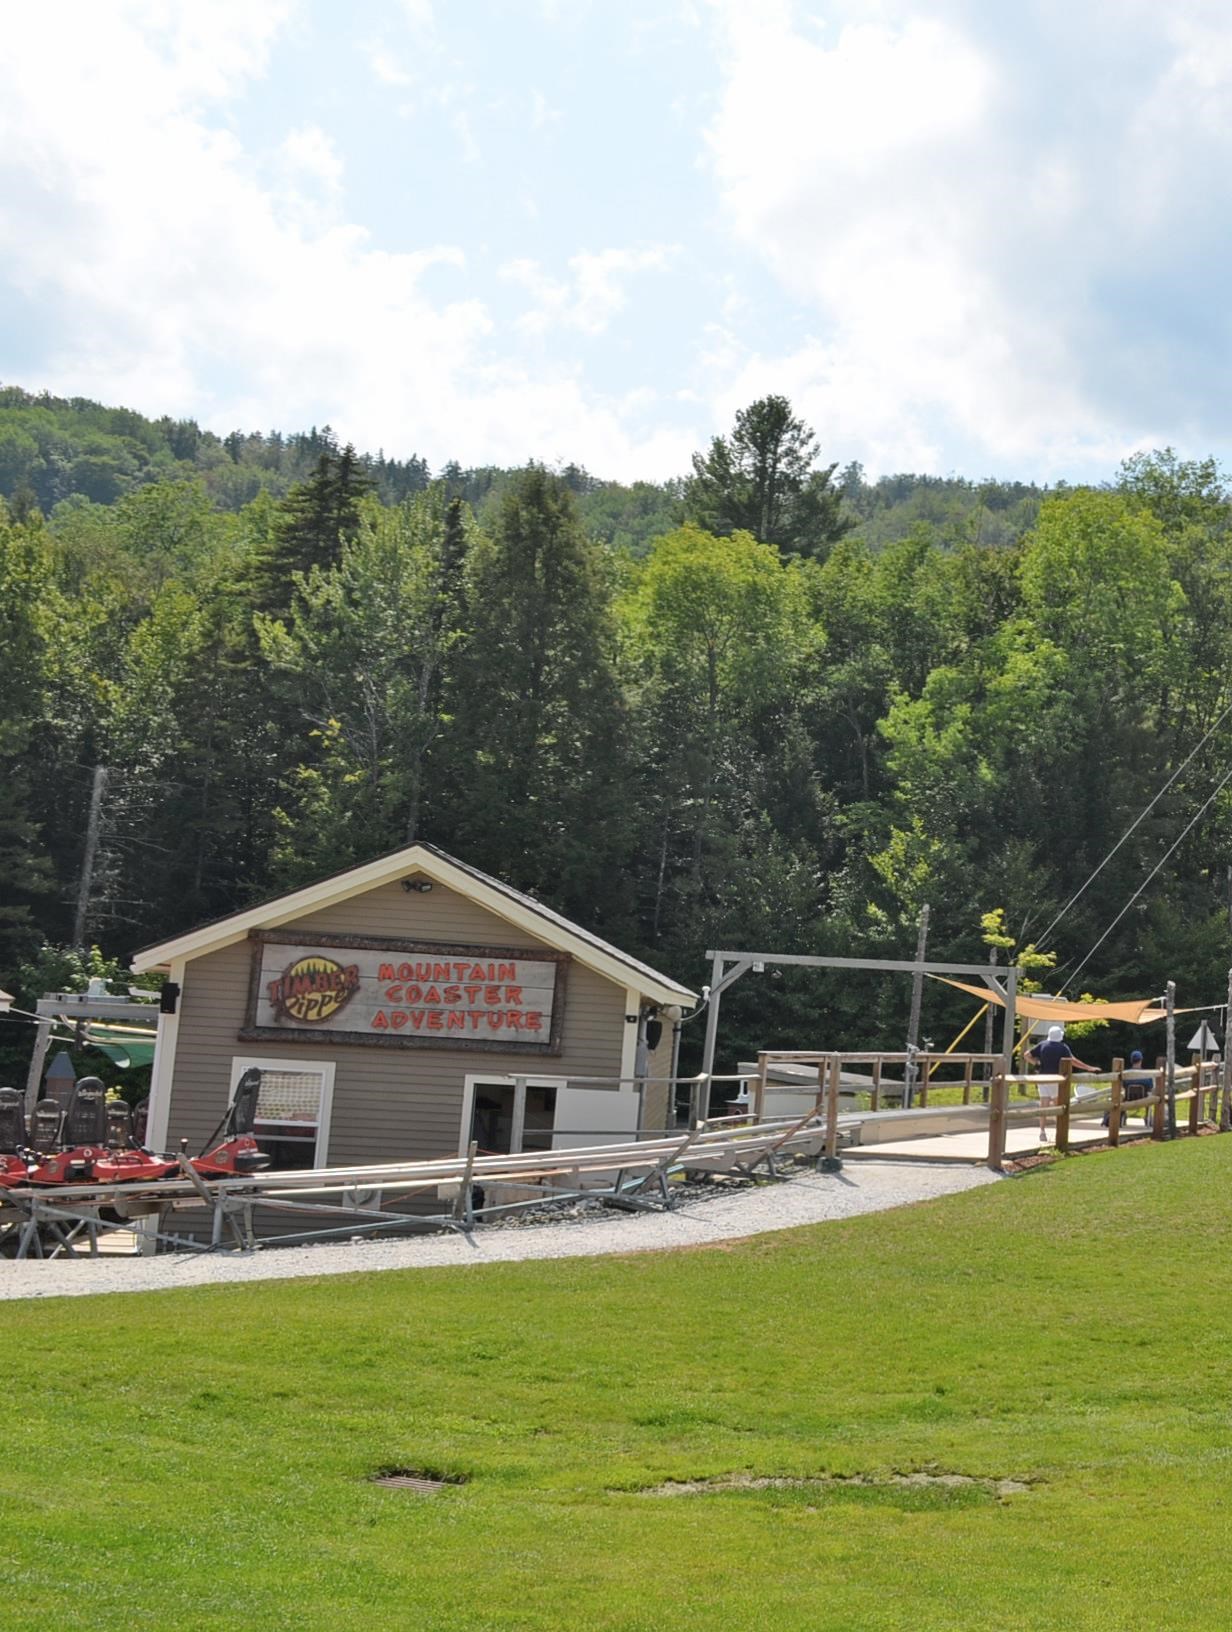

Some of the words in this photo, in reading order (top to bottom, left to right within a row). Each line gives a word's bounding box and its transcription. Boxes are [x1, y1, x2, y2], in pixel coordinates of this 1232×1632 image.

[377, 962, 516, 982] MOUNTAIN
[267, 964, 360, 1002] TIMBER
[385, 984, 523, 1005] COASTER
[371, 1009, 543, 1030] ADVENTURE
